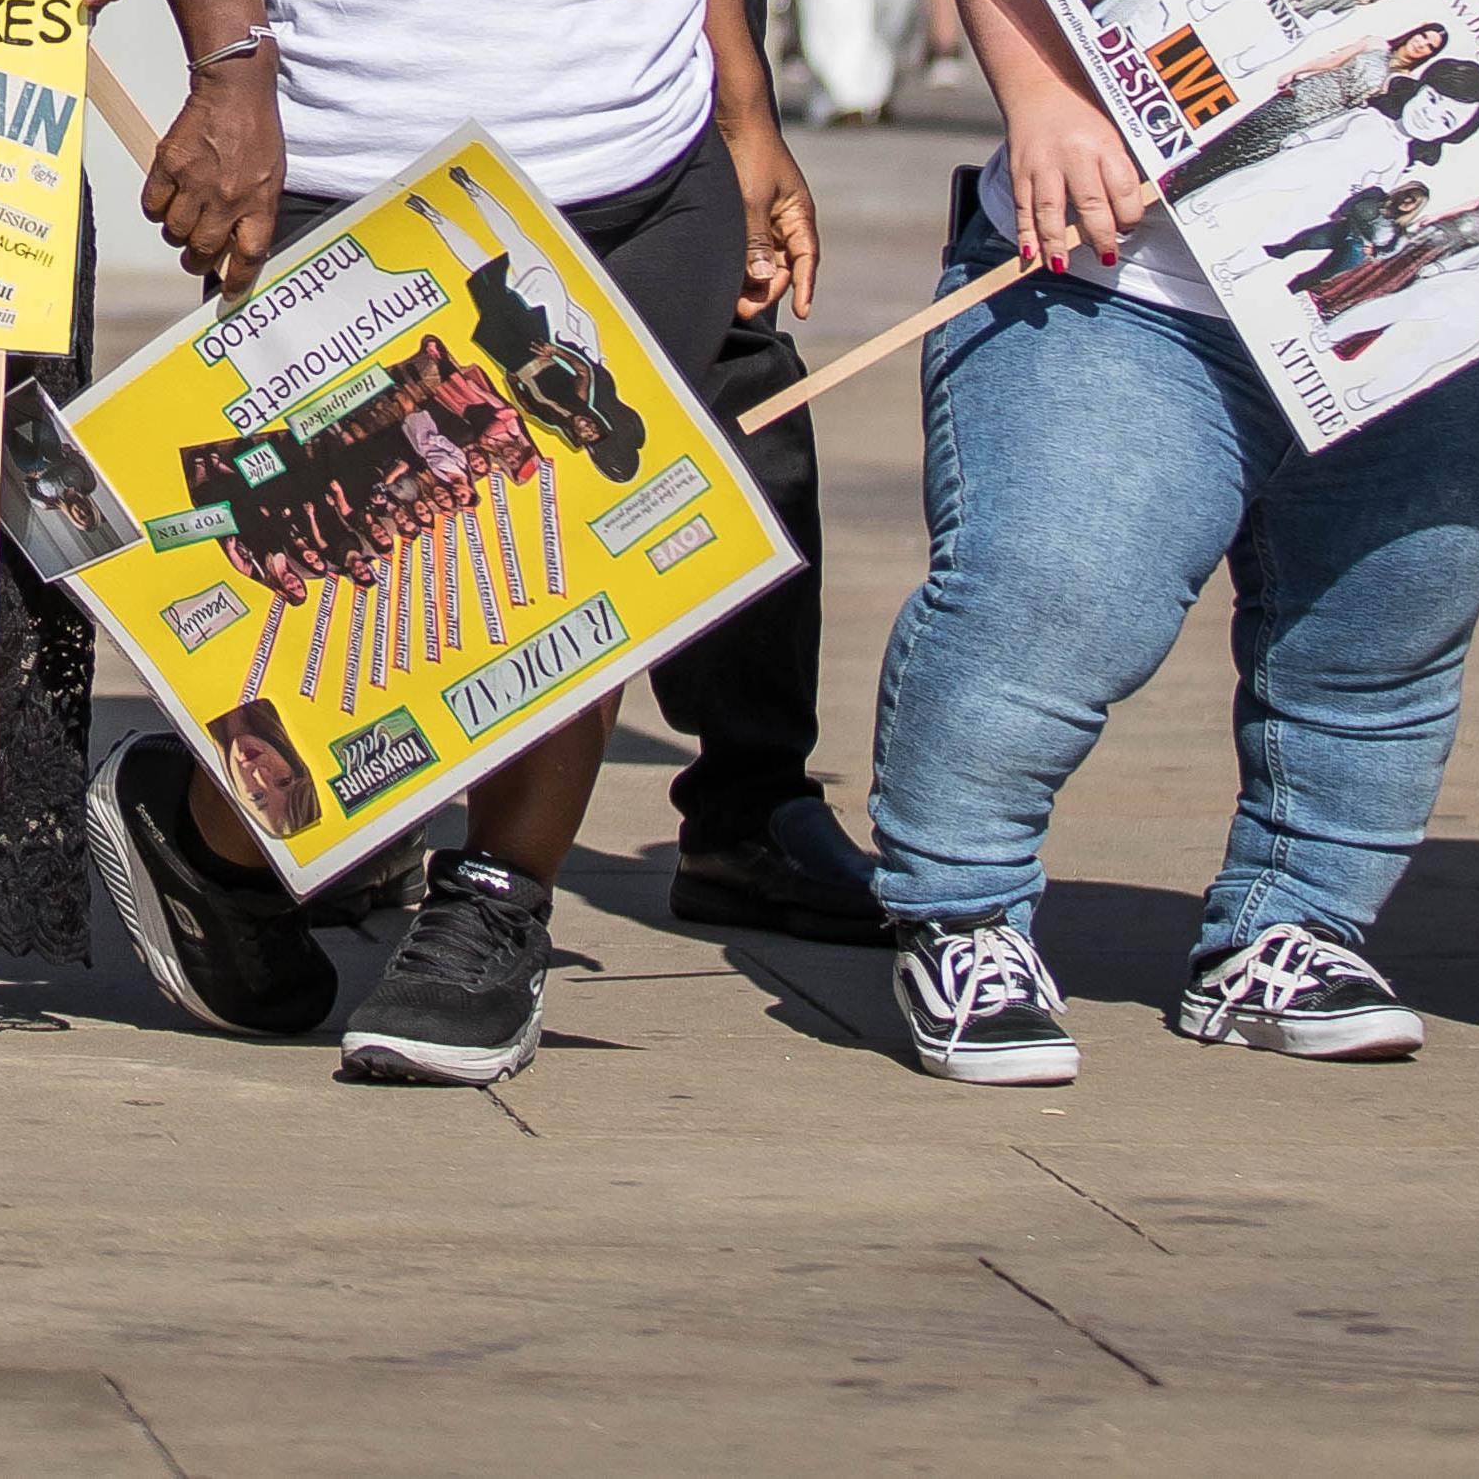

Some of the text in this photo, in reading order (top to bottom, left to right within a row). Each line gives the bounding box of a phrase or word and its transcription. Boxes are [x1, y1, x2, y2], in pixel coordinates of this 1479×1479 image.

[1096, 23, 1196, 158] DESIGN
[1145, 25, 1240, 131] LIVE
[1125, 115, 1144, 139] too
[203, 239, 365, 360] matterstoo
[228, 274, 440, 430] #mysilhouette
[299, 373, 378, 437] Handpicked
[1270, 336, 1349, 436] ATTIRE
[243, 449, 273, 467] MIX
[156, 511, 226, 540] TOP TEN
[167, 591, 240, 644] beauty
[451, 599, 612, 725] RADICAL
[335, 737, 427, 802] YORKSHIRE
[343, 723, 391, 776] Gold
